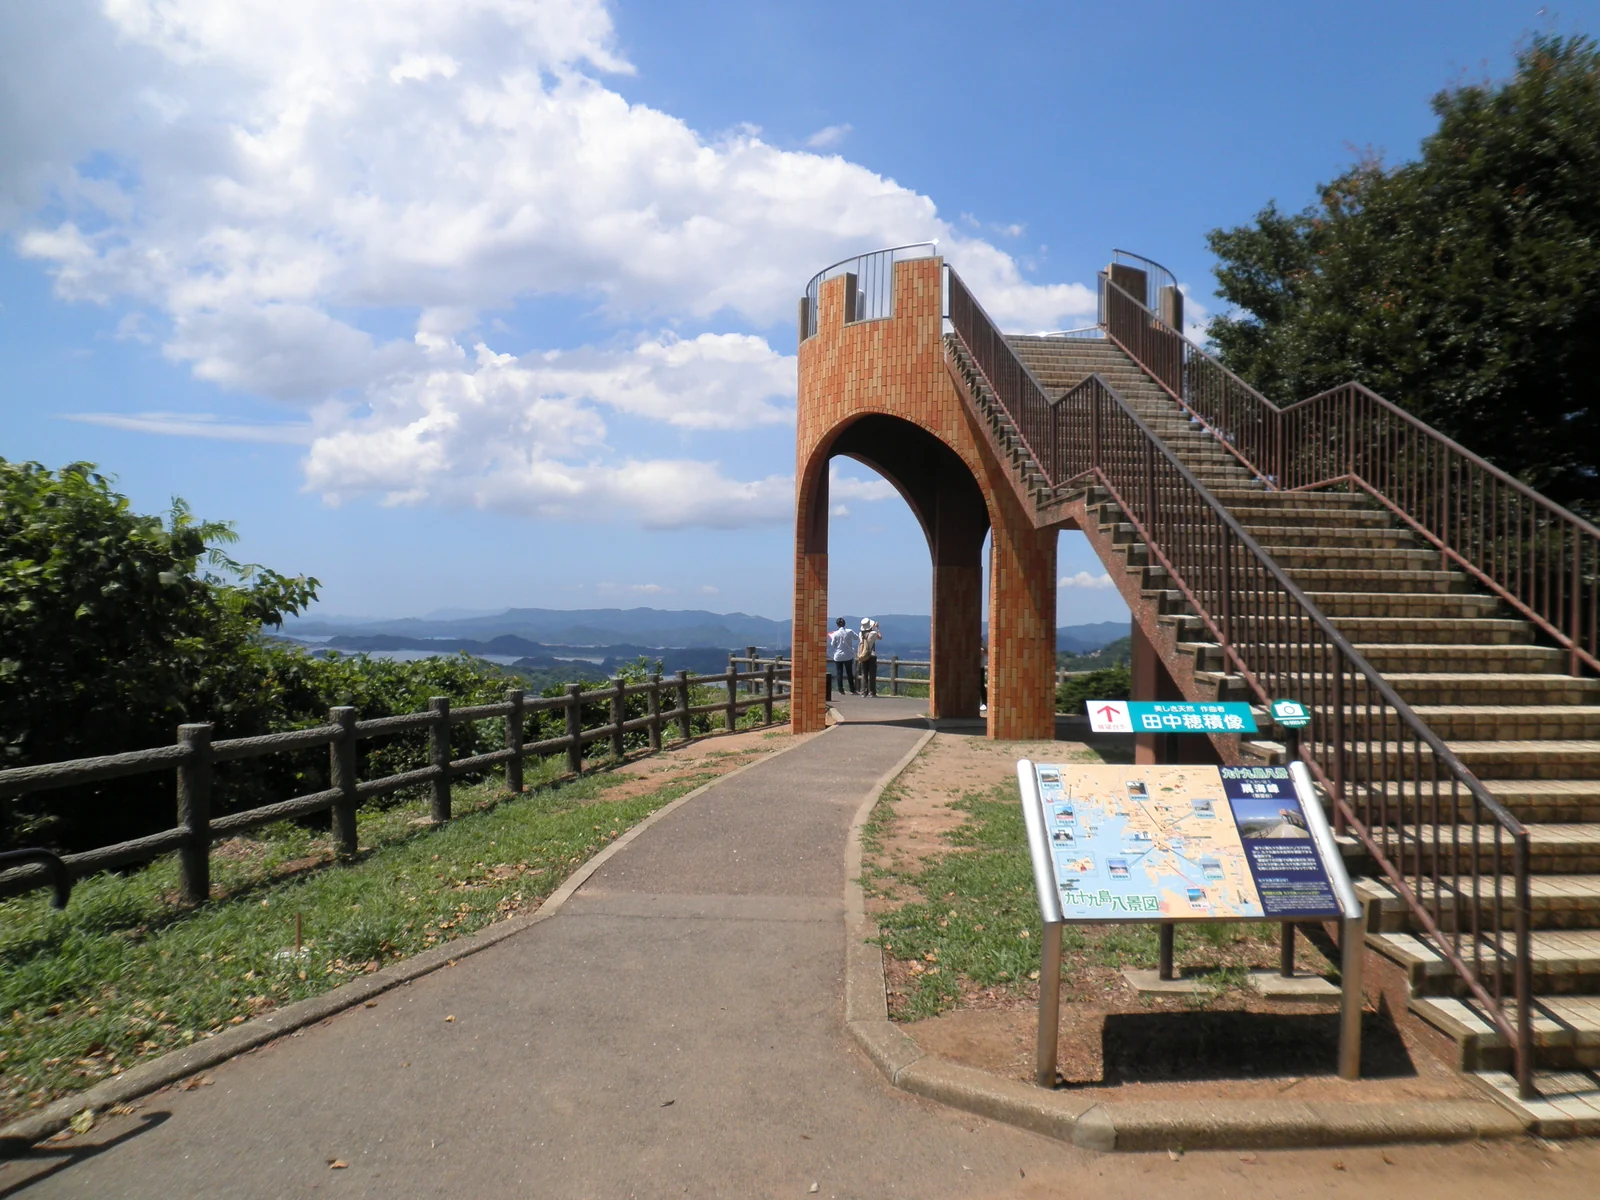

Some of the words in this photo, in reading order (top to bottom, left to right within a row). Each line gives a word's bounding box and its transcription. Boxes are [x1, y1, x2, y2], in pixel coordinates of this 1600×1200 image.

[1141, 713, 1245, 730] 田中穂積像
[1064, 888, 1160, 912] 九十九島八景図
